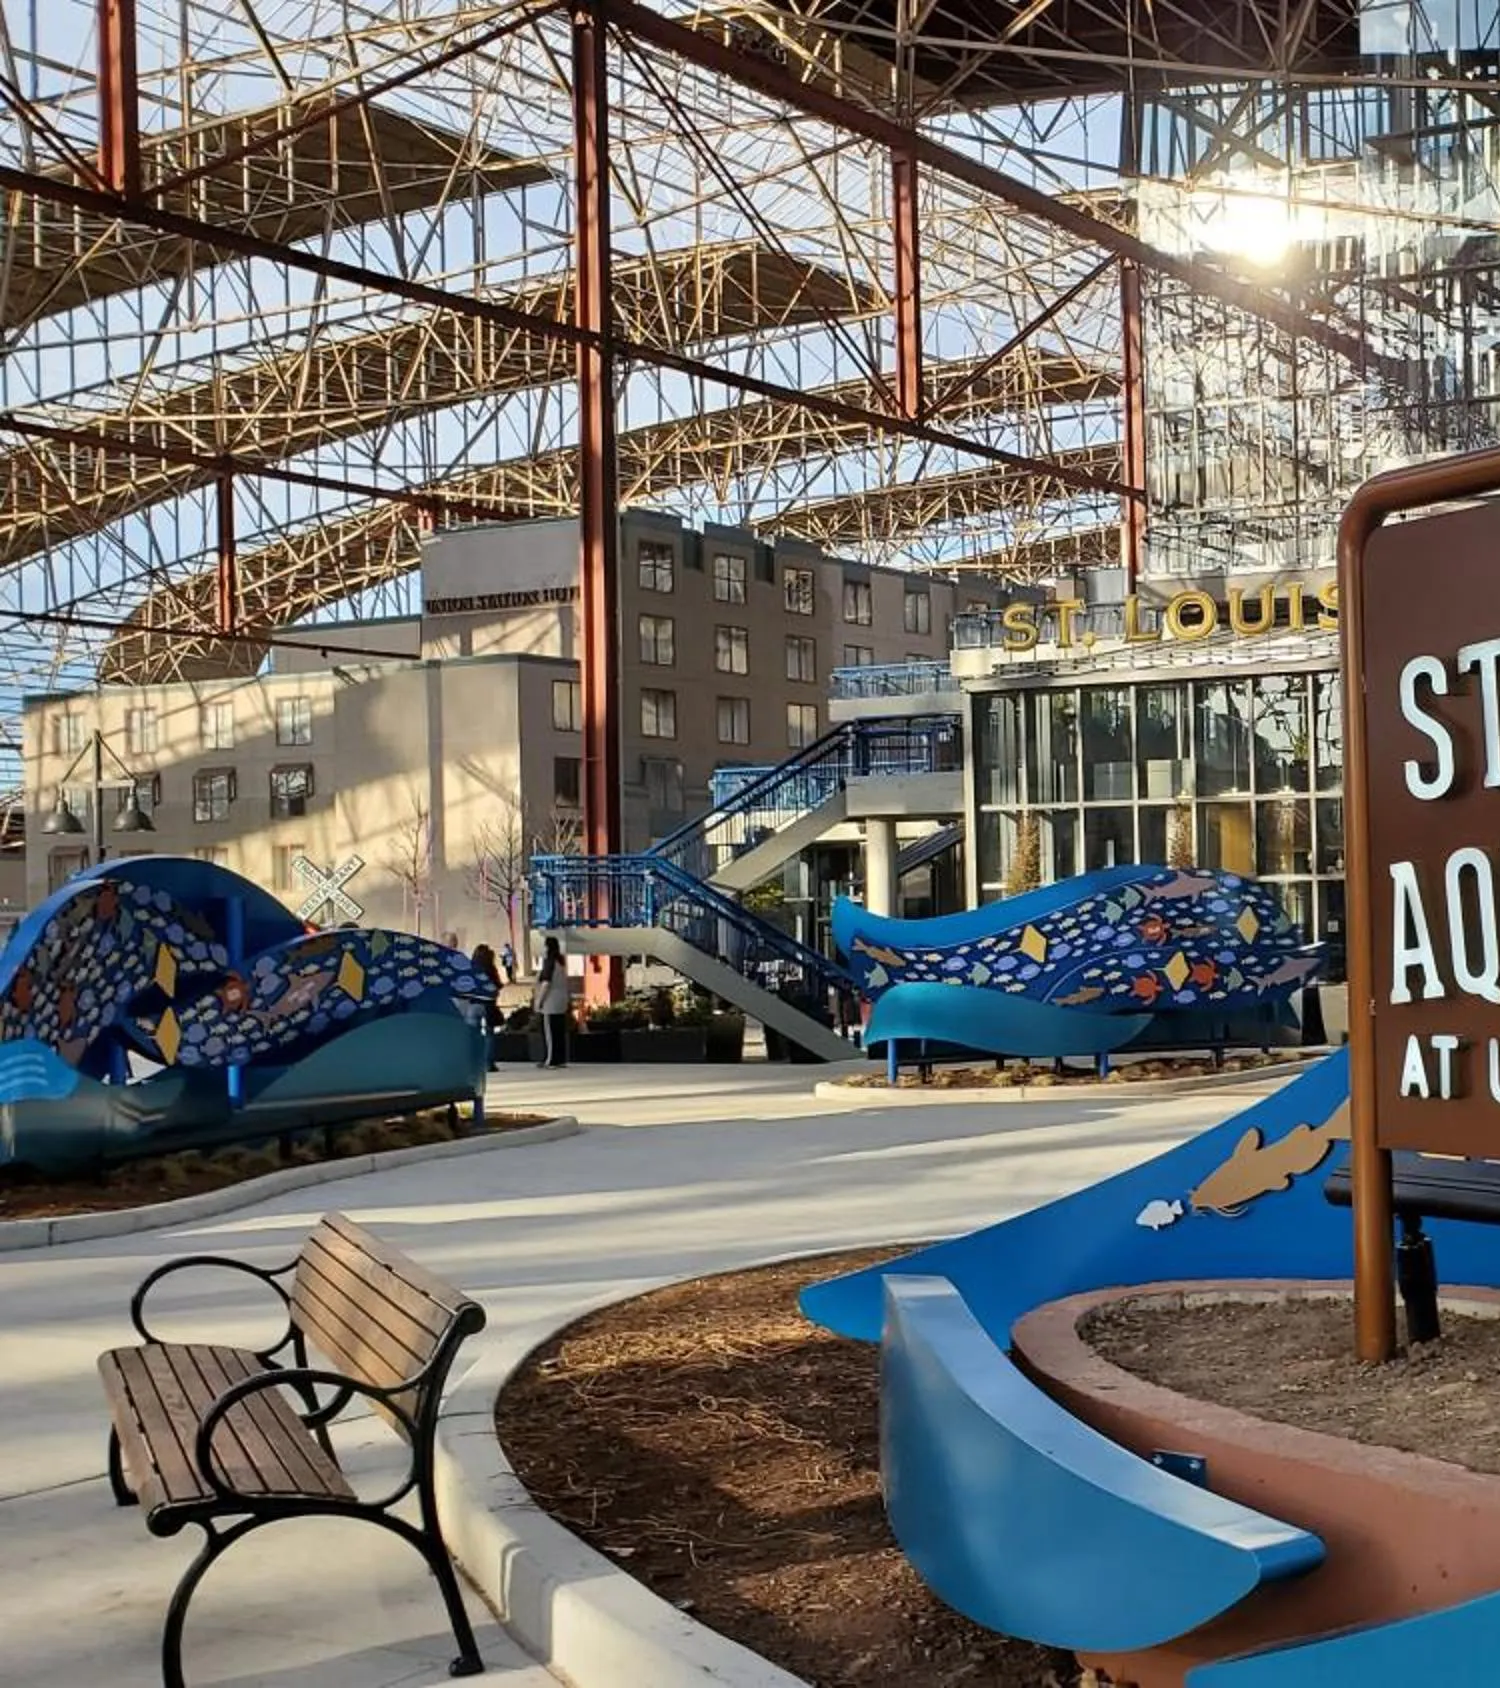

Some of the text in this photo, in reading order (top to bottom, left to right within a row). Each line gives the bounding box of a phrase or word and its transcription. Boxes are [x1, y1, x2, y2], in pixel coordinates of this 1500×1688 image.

[1003, 581, 1339, 652] ST. LOUIS
[1400, 1035, 1459, 1099] AT
